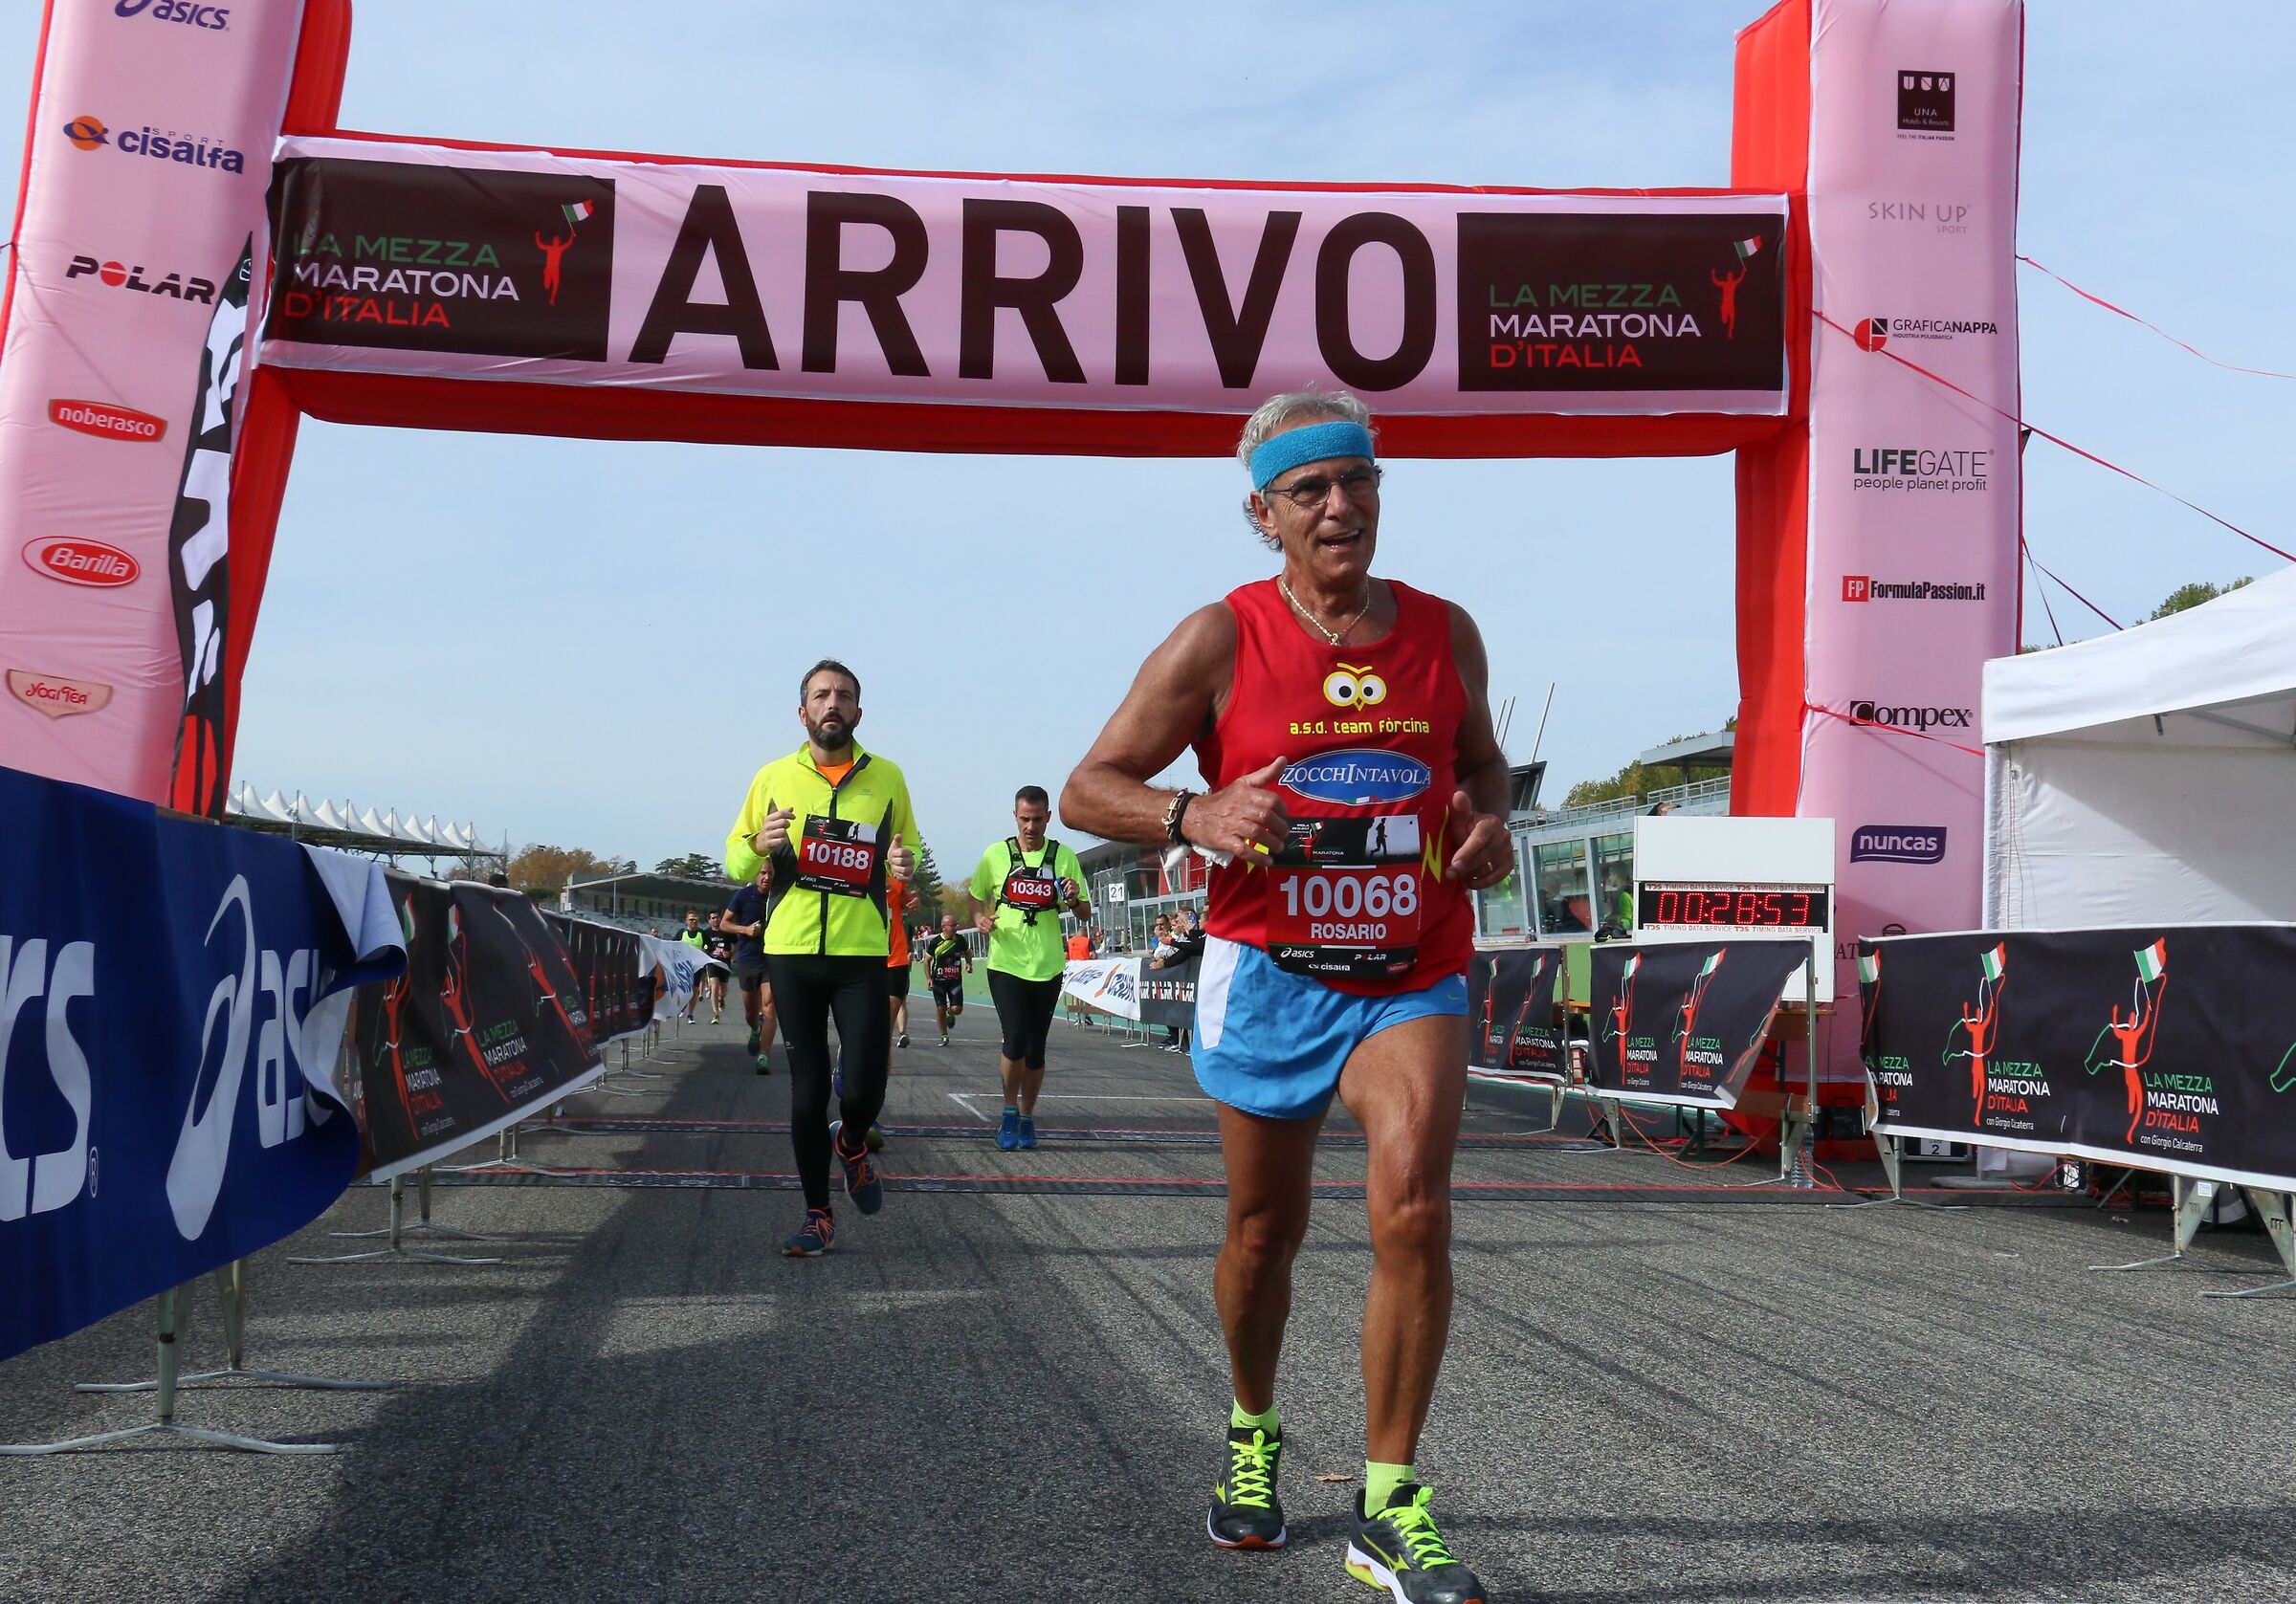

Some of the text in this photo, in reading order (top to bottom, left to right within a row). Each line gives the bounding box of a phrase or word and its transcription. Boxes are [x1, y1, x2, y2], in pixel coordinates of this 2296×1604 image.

[153, 0, 230, 30] asics
[1914, 107, 1937, 116] UNA
[152, 127, 224, 144] SPORT
[118, 126, 245, 174] cisalfa
[1868, 202, 1967, 222] SKIN UP
[1936, 225, 1968, 233] SPORT
[294, 232, 499, 268] LA MEZZA
[66, 255, 215, 304] POLAR
[293, 262, 519, 301] MARATONA
[628, 184, 1437, 392] ARRIVO
[1490, 284, 1681, 307] LA MEZZA
[284, 290, 450, 329] D'ITALIA
[1490, 314, 1701, 338] MARATONA
[1893, 319, 1998, 335] GRAFICANAPPA
[1490, 341, 1643, 368] D'ITALIA
[58, 406, 157, 436] noberasco
[1854, 449, 1987, 477] LIFEGATE
[1854, 477, 1987, 493] people planet profit
[49, 547, 130, 578] Barilla
[1847, 580, 1985, 601] FP FormulaPassion.it
[26, 682, 88, 705] YOGI TEA
[1290, 717, 1430, 735] a.s.d. team fòrcina
[1849, 700, 1971, 731] Compex
[1282, 763, 1432, 785] ZOCCHINTAVOLA
[1860, 834, 1937, 851] nuncas
[806, 842, 870, 870] 10188
[1011, 881, 1051, 896] 10343
[1111, 887, 1124, 897] 21
[1279, 874, 1418, 917] 10068
[1658, 892, 1809, 925] 00:28:53
[1311, 923, 1386, 940] ROSARIO
[1292, 950, 1314, 958] asics
[1321, 962, 1350, 971] cisalfa
[1525, 1025, 1550, 1038] MEZZA
[483, 1036, 528, 1066] MARATONA
[1515, 1036, 1556, 1050] MARATONA
[1627, 1037, 1655, 1048] LA MEZZA
[1687, 1037, 1720, 1050] LA MEZZA
[1626, 1050, 1658, 1062] MARATONA
[1685, 1050, 1723, 1066] MARATONA
[1987, 1060, 2043, 1077] LA MEZZA
[405, 1067, 442, 1092] MARATONA
[1988, 1078, 2051, 1096] MARATONA
[2144, 1071, 2213, 1093] LA MEZZA
[2147, 1090, 2219, 1115] MARATONA
[1986, 1117, 1995, 1126] con
[2145, 1110, 2199, 1133] D'ITALIA
[1932, 1144, 1939, 1155] 2
[2140, 1134, 2203, 1153] con Giorgio Calcaterra
